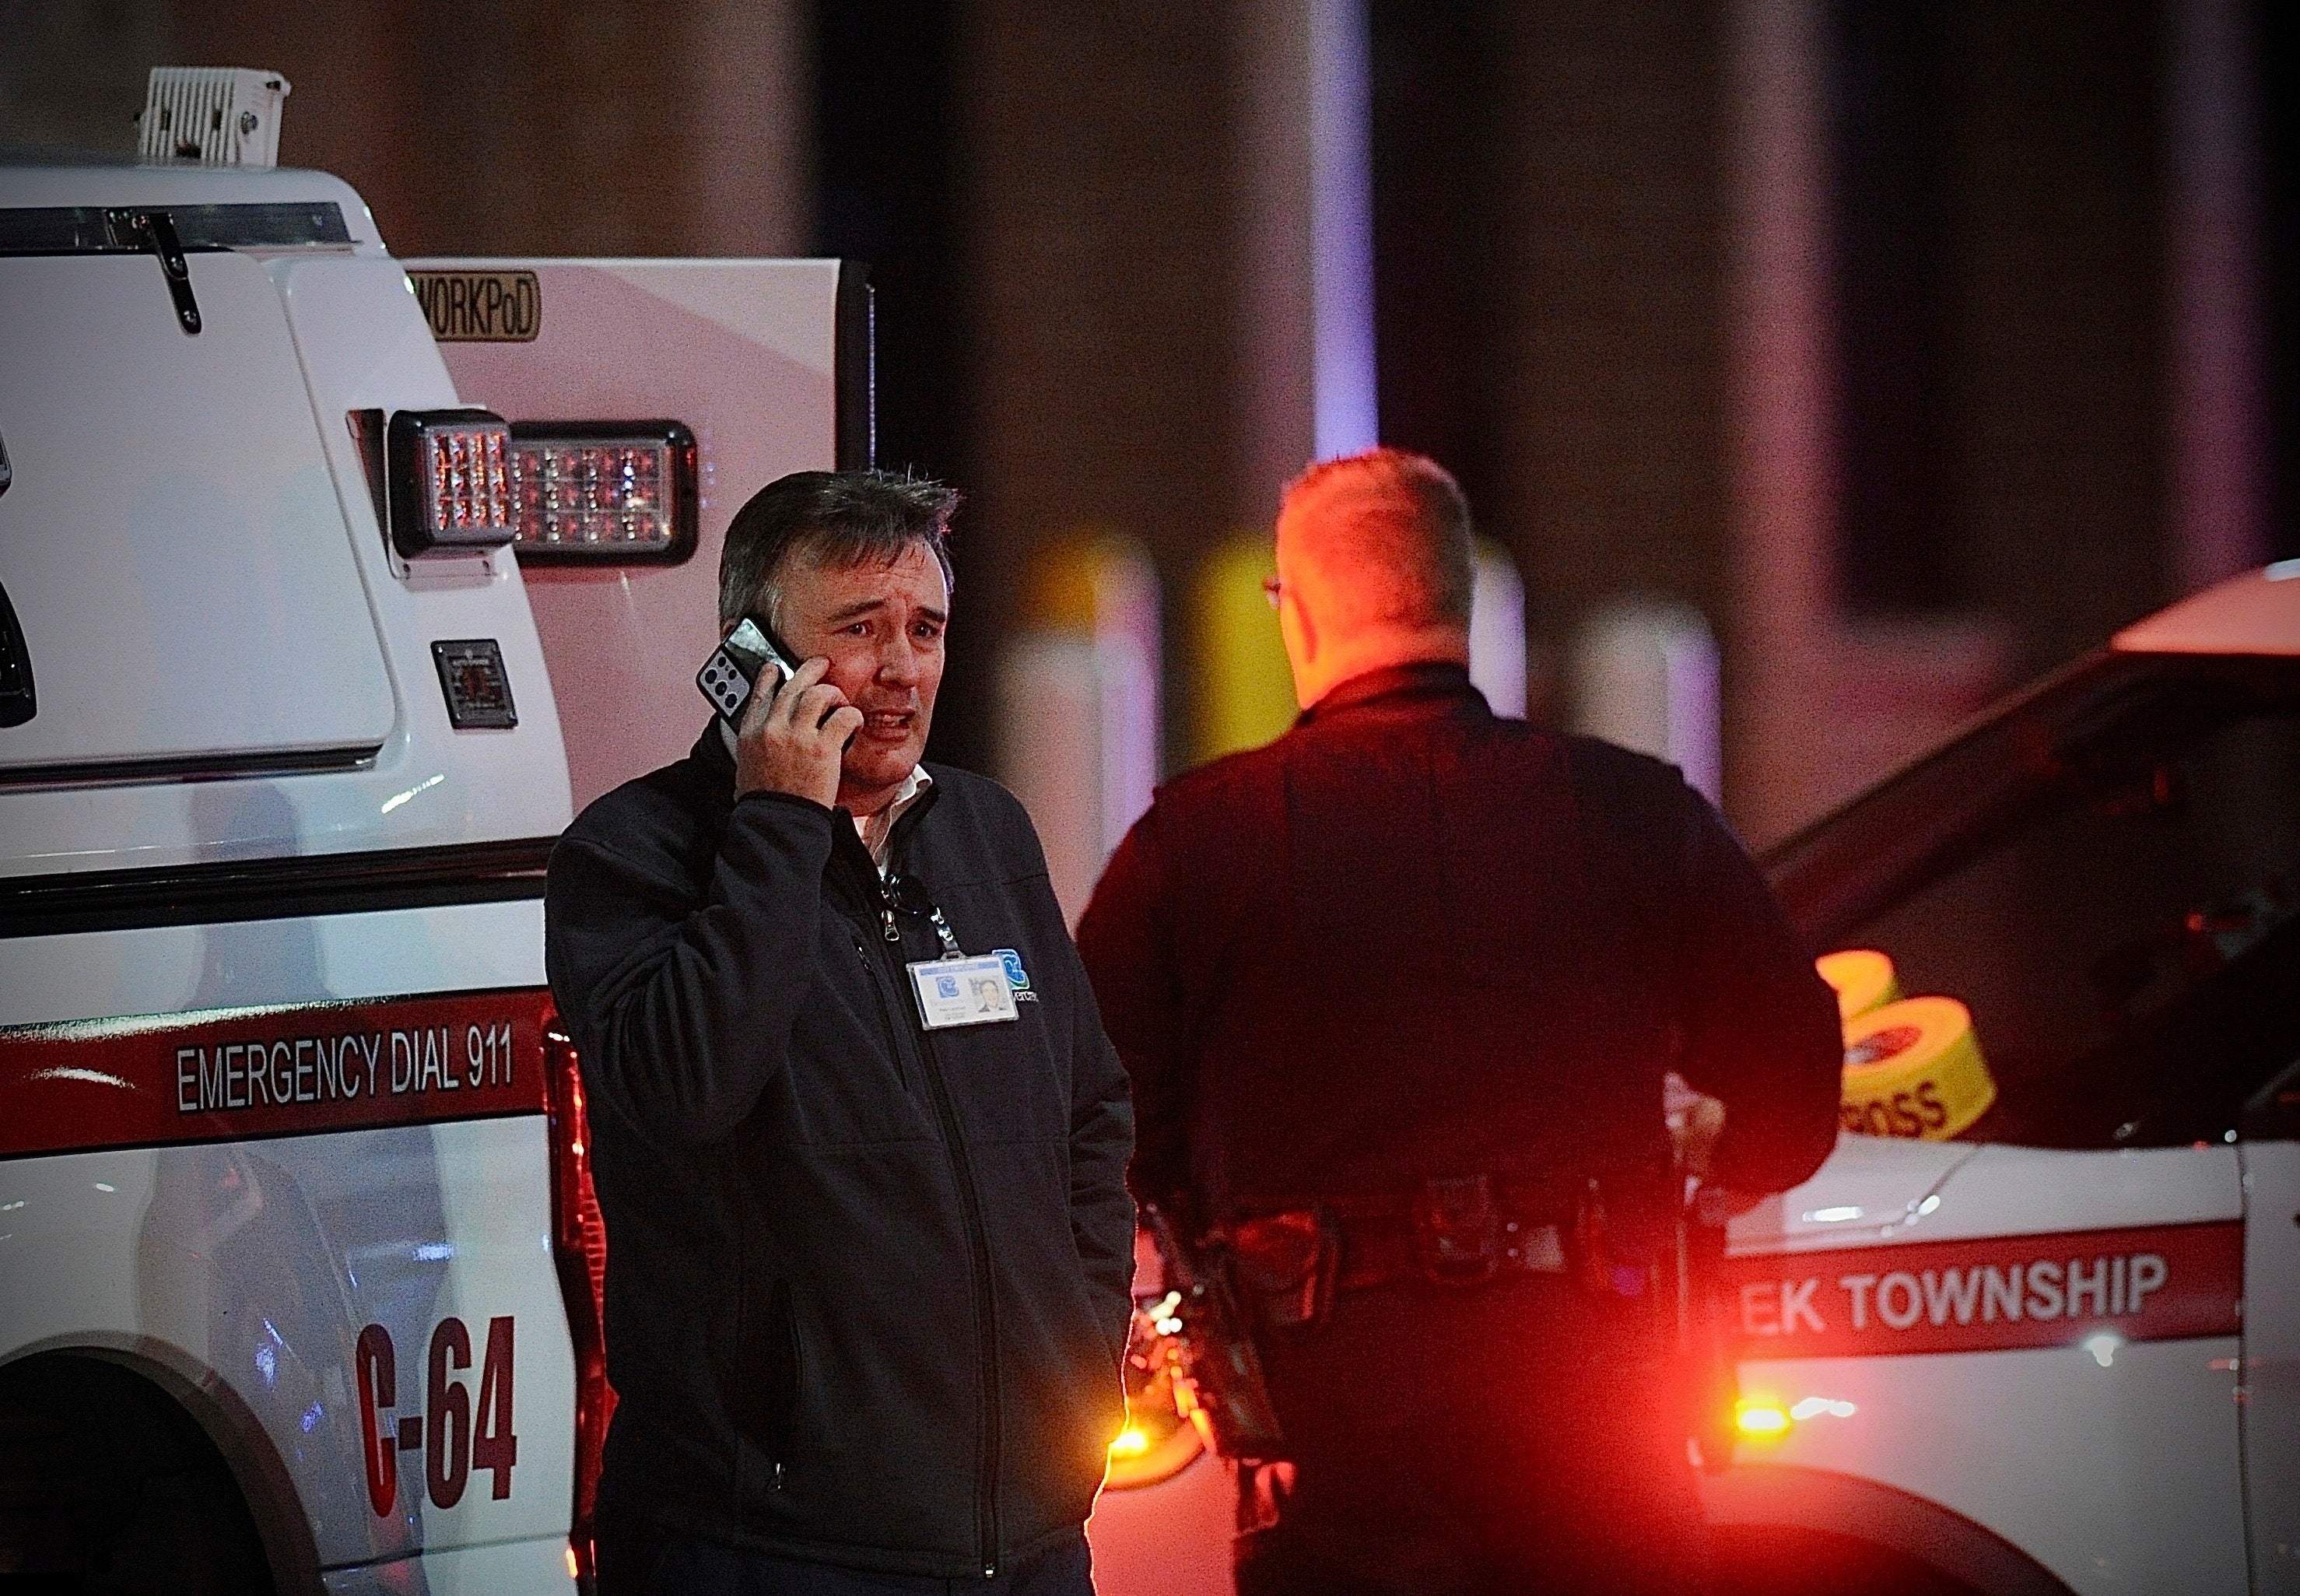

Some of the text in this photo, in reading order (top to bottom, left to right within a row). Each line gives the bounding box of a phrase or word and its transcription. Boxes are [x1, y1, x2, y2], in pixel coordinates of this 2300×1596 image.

[177, 1023, 510, 1111] EMERGENCY DIAL 911
[1838, 1253, 2168, 1330] TOWNSHIP
[356, 1316, 517, 1518] C-64
